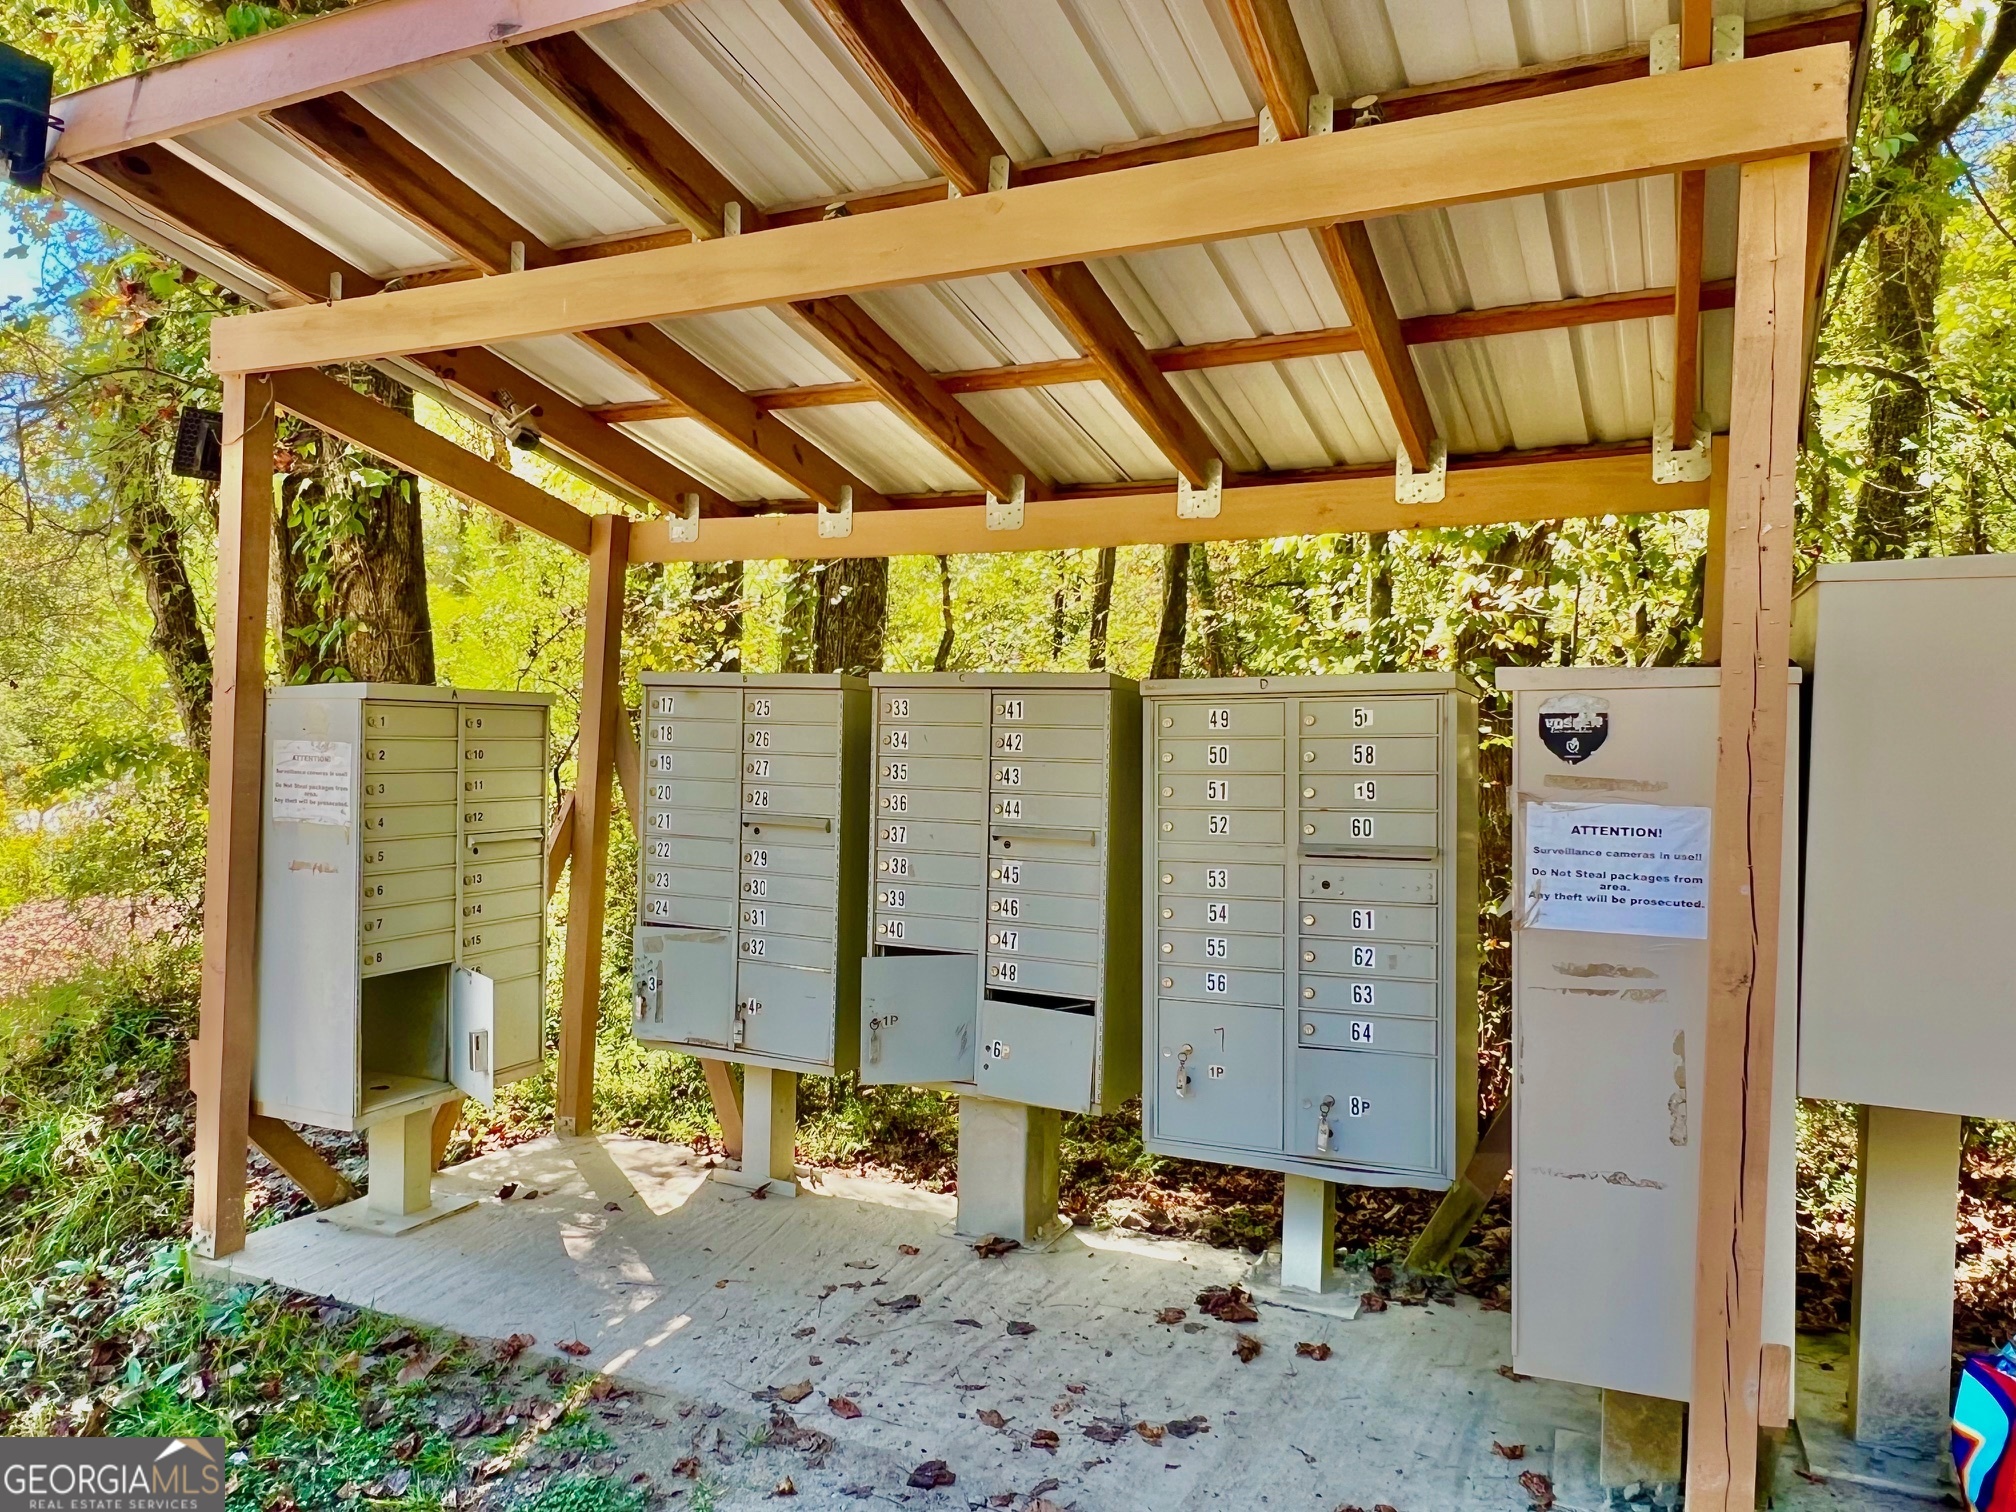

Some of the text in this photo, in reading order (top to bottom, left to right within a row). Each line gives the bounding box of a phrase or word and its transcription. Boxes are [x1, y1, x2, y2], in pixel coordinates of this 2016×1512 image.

[1259, 678, 1269, 690] D
[451, 689, 459, 701] A
[661, 697, 674, 713] 17
[756, 700, 770, 716] 25
[893, 700, 909, 716] 33
[1006, 701, 1022, 718] 41
[380, 716, 385, 727] 1
[476, 718, 482, 729] 9
[1209, 710, 1229, 728] 49
[660, 726, 673, 741] 18
[755, 731, 770, 747] 26
[892, 732, 908, 748] 34
[1006, 734, 1022, 751] 42
[379, 750, 386, 761] 2
[474, 750, 484, 760] 10
[660, 755, 672, 770] 19
[1208, 746, 1228, 764] 50
[1354, 745, 1374, 764] 58
[755, 760, 769, 776] 27
[892, 764, 907, 780] 35
[1003, 768, 1020, 784] 43
[378, 784, 385, 794] 3
[473, 781, 483, 790] 11
[658, 785, 671, 800] 20
[1208, 781, 1226, 799] 51
[1357, 781, 1375, 800] 19
[754, 791, 768, 806] 28
[891, 795, 907, 811] 36
[473, 812, 483, 822] 12
[1004, 801, 1020, 817] 44
[377, 818, 384, 828] 4
[657, 813, 670, 828] 21
[1209, 816, 1228, 834] 52
[1352, 819, 1372, 837] 60
[891, 826, 906, 842] 37
[1571, 825, 1663, 838] ATTENTION!
[377, 851, 384, 861] 5
[657, 843, 670, 857] 22
[753, 850, 767, 866] 29
[1533, 846, 1602, 857] Surveillance
[1605, 851, 1656, 860] cameras
[1659, 851, 1670, 860] in
[891, 858, 907, 874] 38
[472, 874, 482, 884] 13
[656, 873, 669, 888] 23
[1003, 866, 1019, 883] 45
[1208, 870, 1226, 887] 53
[1532, 867, 1703, 884] Do Not Steal packages from
[377, 885, 383, 895] 6
[752, 880, 766, 895] 30
[1599, 883, 1631, 892] area.
[889, 890, 905, 906] 39
[1528, 890, 1706, 909] Any theft will be prosecuted.
[471, 904, 482, 914] 14
[655, 901, 668, 915] 24
[1002, 899, 1018, 916] 46
[1208, 904, 1226, 922] 54
[376, 919, 383, 929] 7
[751, 910, 765, 925] 31
[1352, 910, 1372, 929] 61
[888, 922, 903, 938] 40
[470, 935, 481, 945] 15
[750, 940, 764, 955] 32
[1001, 932, 1017, 949] 47
[1206, 939, 1225, 957] 55
[376, 952, 383, 963] 8
[1354, 947, 1373, 967] 62
[1000, 964, 1016, 981] 48
[1206, 973, 1226, 992] 56
[1352, 985, 1372, 1004] 63
[883, 1015, 899, 1026] 1P
[1351, 1022, 1371, 1042] 64
[1209, 1066, 1224, 1078] 1P
[1351, 1097, 1370, 1116] 8P
